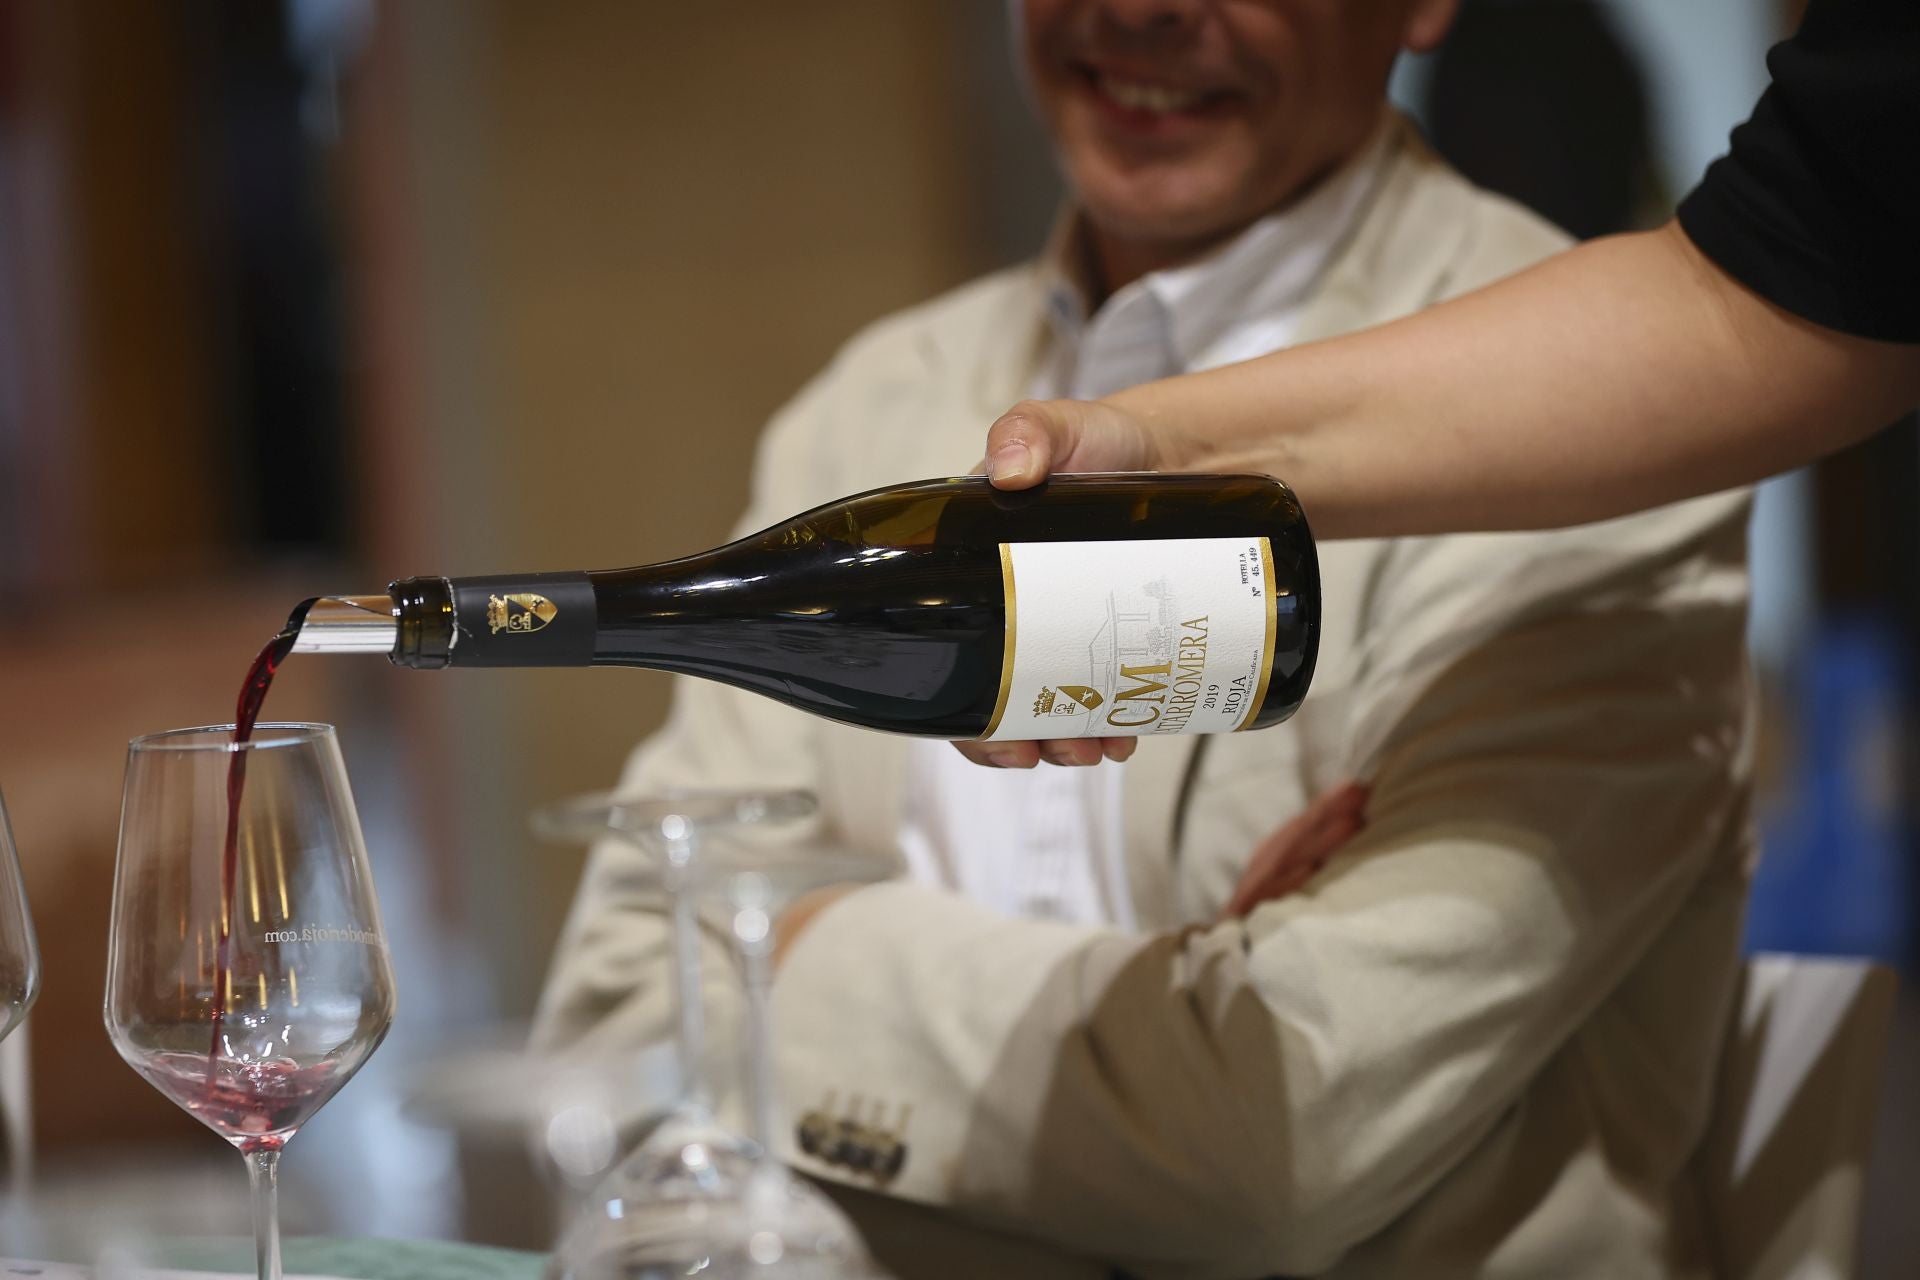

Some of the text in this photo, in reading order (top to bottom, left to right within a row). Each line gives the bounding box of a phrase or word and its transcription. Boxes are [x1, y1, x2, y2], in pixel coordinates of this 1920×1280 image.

[1239, 553, 1249, 584] BOTELLA
[1106, 660, 1173, 727] CM
[1152, 615, 1209, 734] ATARROMERA
[1202, 684, 1220, 709] 2019
[1222, 675, 1247, 714] RIOJA
